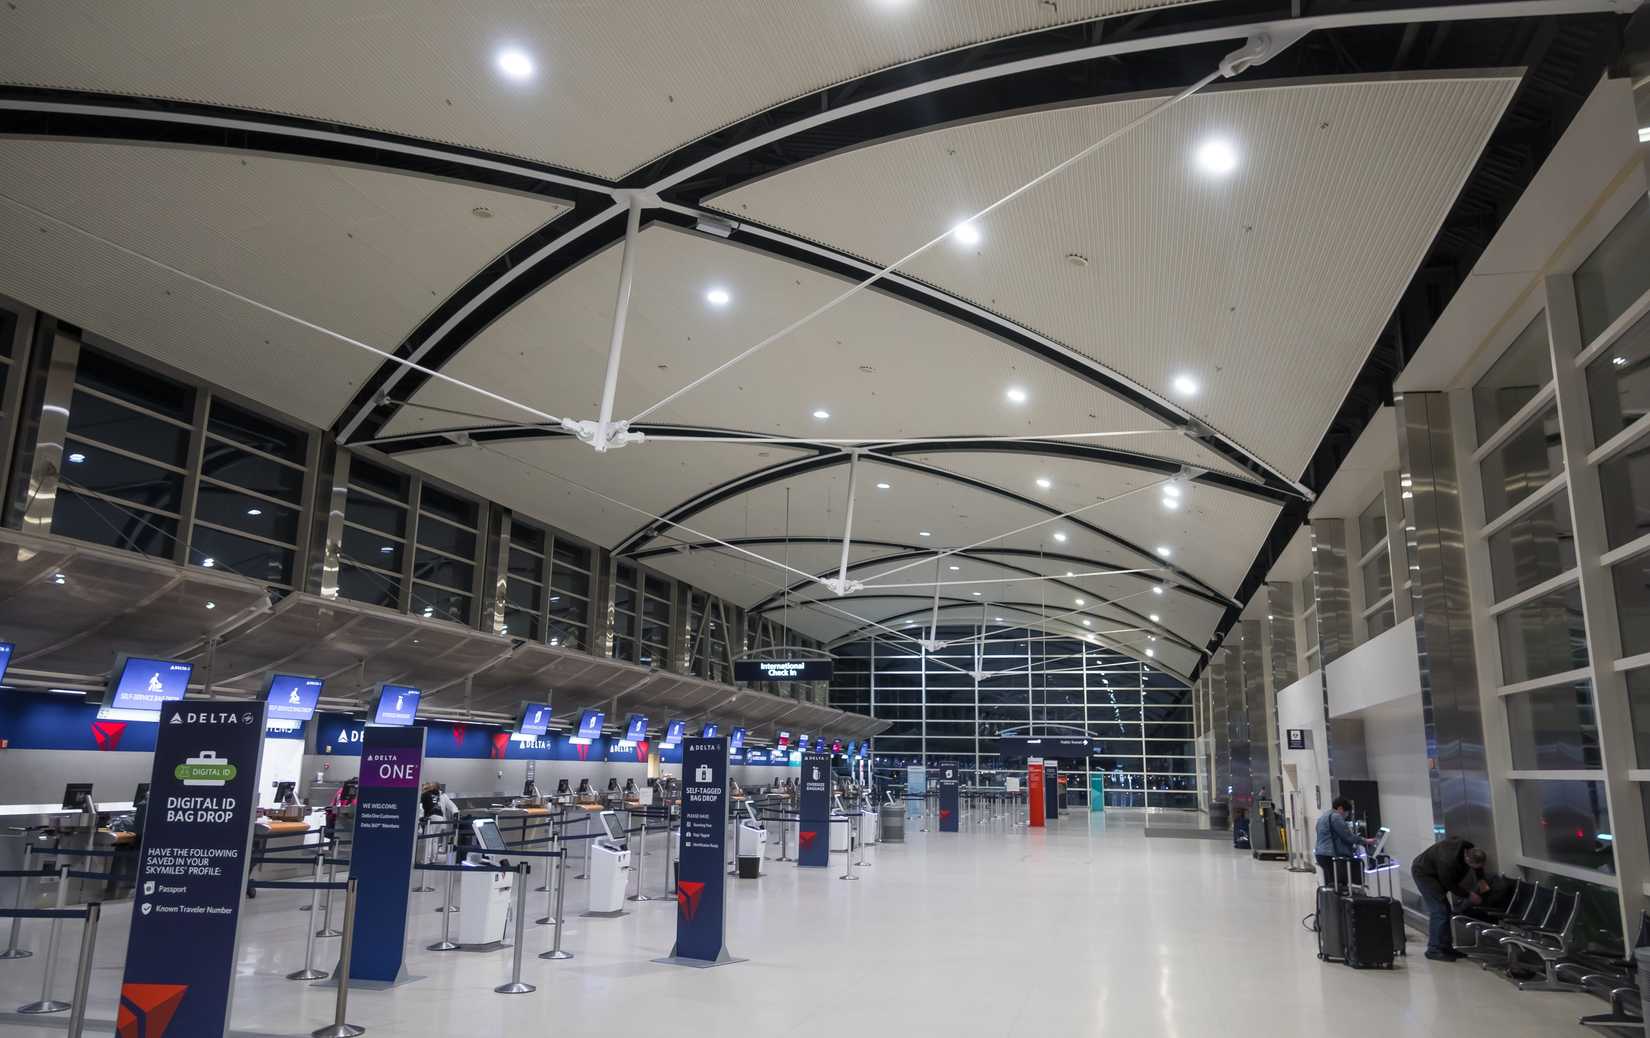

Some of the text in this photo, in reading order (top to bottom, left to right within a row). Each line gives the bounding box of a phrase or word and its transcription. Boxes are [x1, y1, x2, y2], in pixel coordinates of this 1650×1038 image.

[760, 662, 805, 670] International
[187, 713, 238, 724] DELTA
[526, 740, 546, 750] DELTA
[192, 768, 221, 776] DIGITAL
[379, 764, 415, 779] ONE
[686, 787, 722, 795] SELF-TAGGED
[690, 794, 702, 802] BAG
[167, 797, 236, 810] DIGITAL ID
[166, 810, 233, 823] BAG DROP
[148, 848, 238, 858] HAVE THE FOLLOWING
[147, 857, 209, 867] SAVED IN YOUR
[188, 867, 222, 876] PROFILE:
[159, 885, 187, 894] Passport
[156, 905, 178, 913] Known
[179, 906, 206, 914] Traveler
